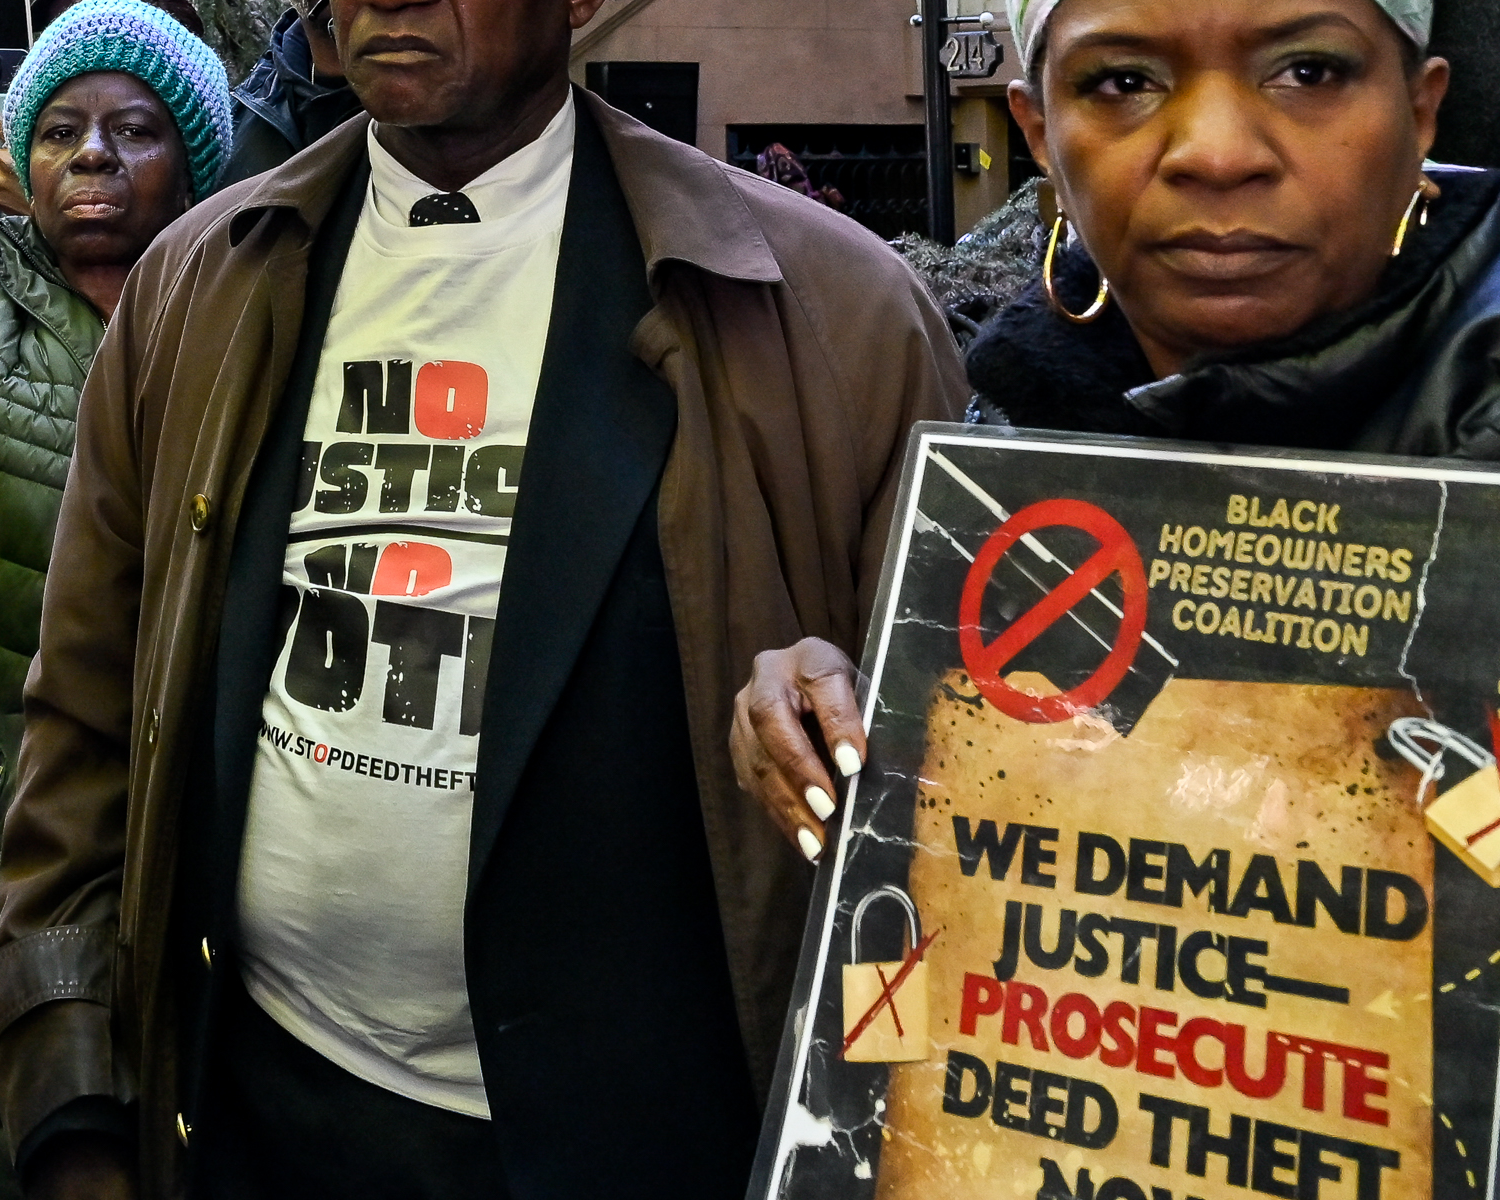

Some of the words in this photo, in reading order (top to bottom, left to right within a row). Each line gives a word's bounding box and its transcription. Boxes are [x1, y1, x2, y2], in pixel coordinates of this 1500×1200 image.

[946, 36, 985, 71] 214
[335, 358, 489, 440] NO
[1226, 493, 1341, 535] BLACK
[303, 541, 453, 598] NO
[1158, 522, 1414, 584] HOMEOWNERS
[1147, 558, 1412, 623] PRESERVATION
[1171, 598, 1370, 658] COALITION
[951, 815, 1058, 890] WE
[1074, 830, 1430, 943] DEMAND
[958, 971, 1391, 1128] PROSECUTE
[941, 1049, 1119, 1150] DEED
[1138, 1091, 1401, 1200] THEFT
